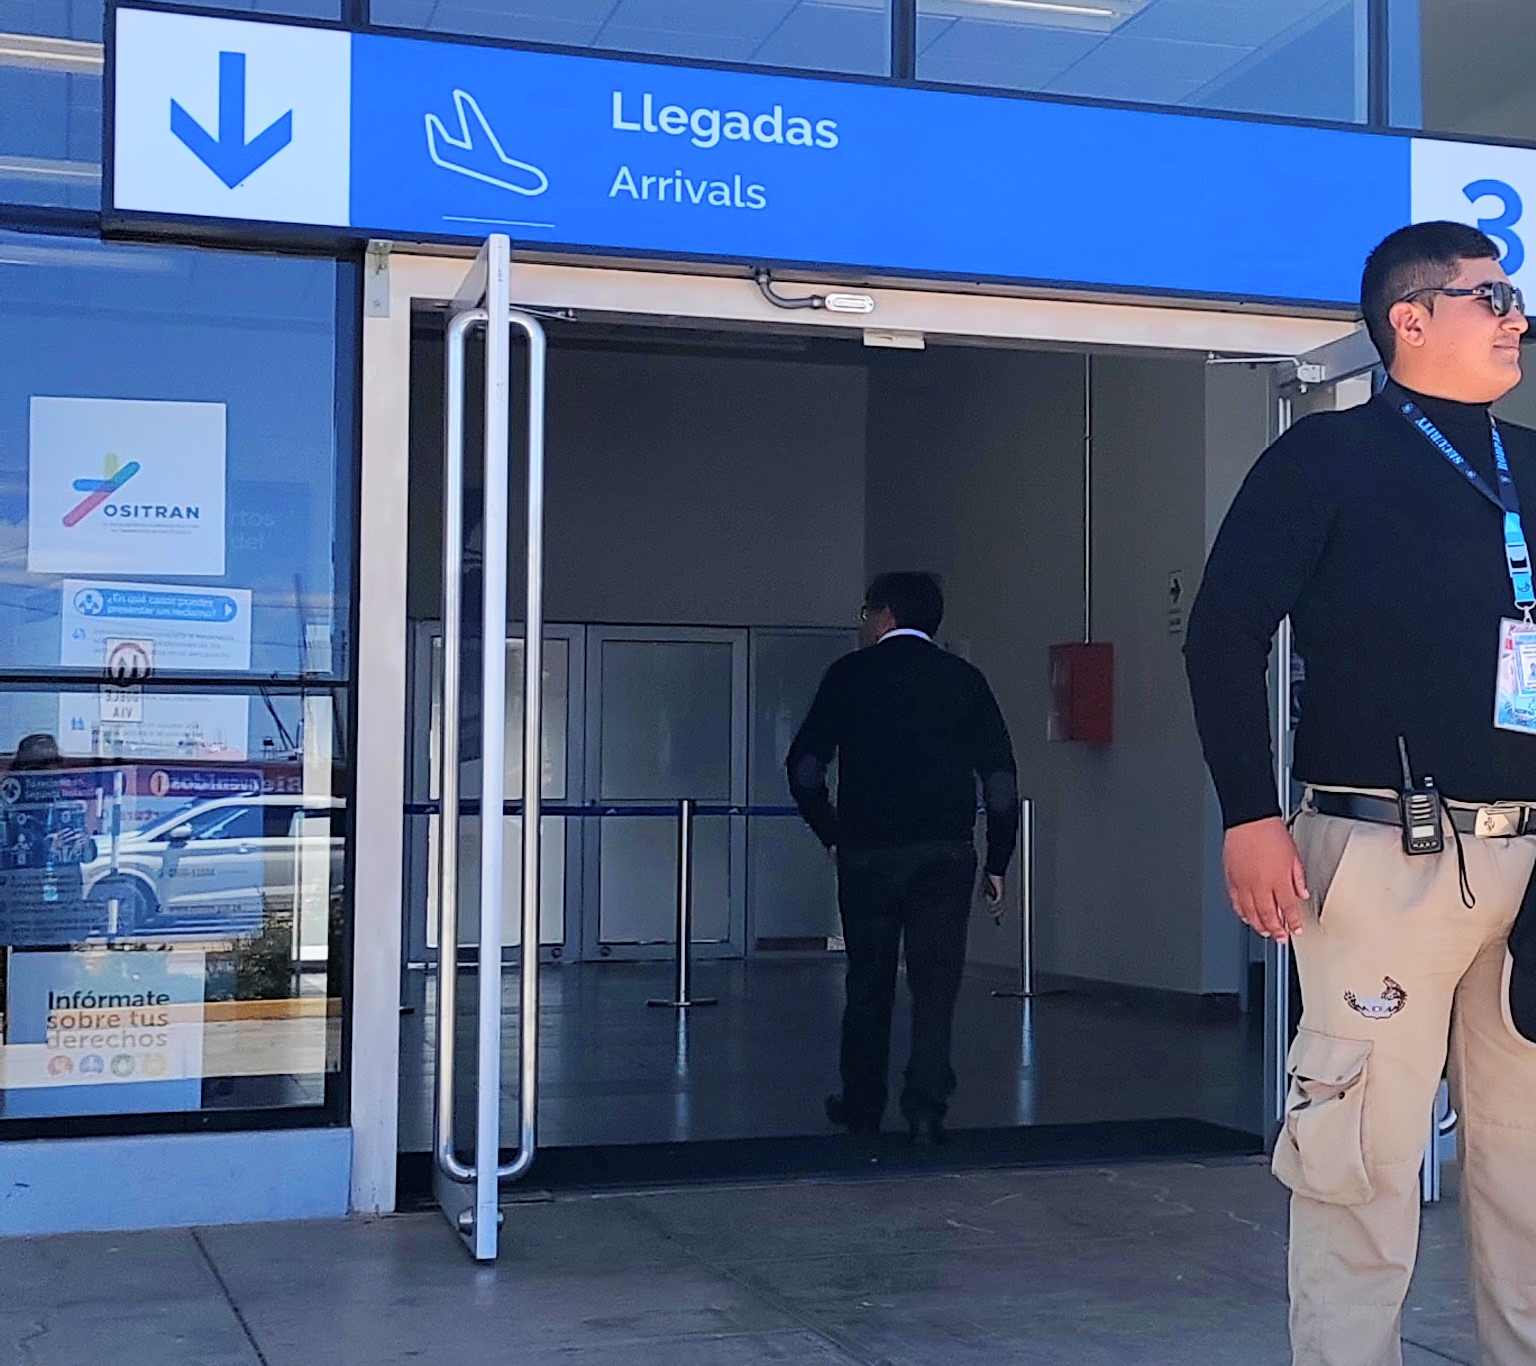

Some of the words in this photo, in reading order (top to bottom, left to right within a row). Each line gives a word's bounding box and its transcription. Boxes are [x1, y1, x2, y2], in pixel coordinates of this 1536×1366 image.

[612, 91, 839, 148] Llegadas
[608, 166, 766, 209] Arrivals
[1462, 179, 1525, 276] 3
[1415, 417, 1464, 464] SECURITY
[103, 504, 200, 520] OSITRAN
[48, 990, 171, 1010] Infórmate
[47, 1011, 121, 1030] sobre
[129, 1010, 169, 1027] tus
[47, 1030, 169, 1050] derechos
